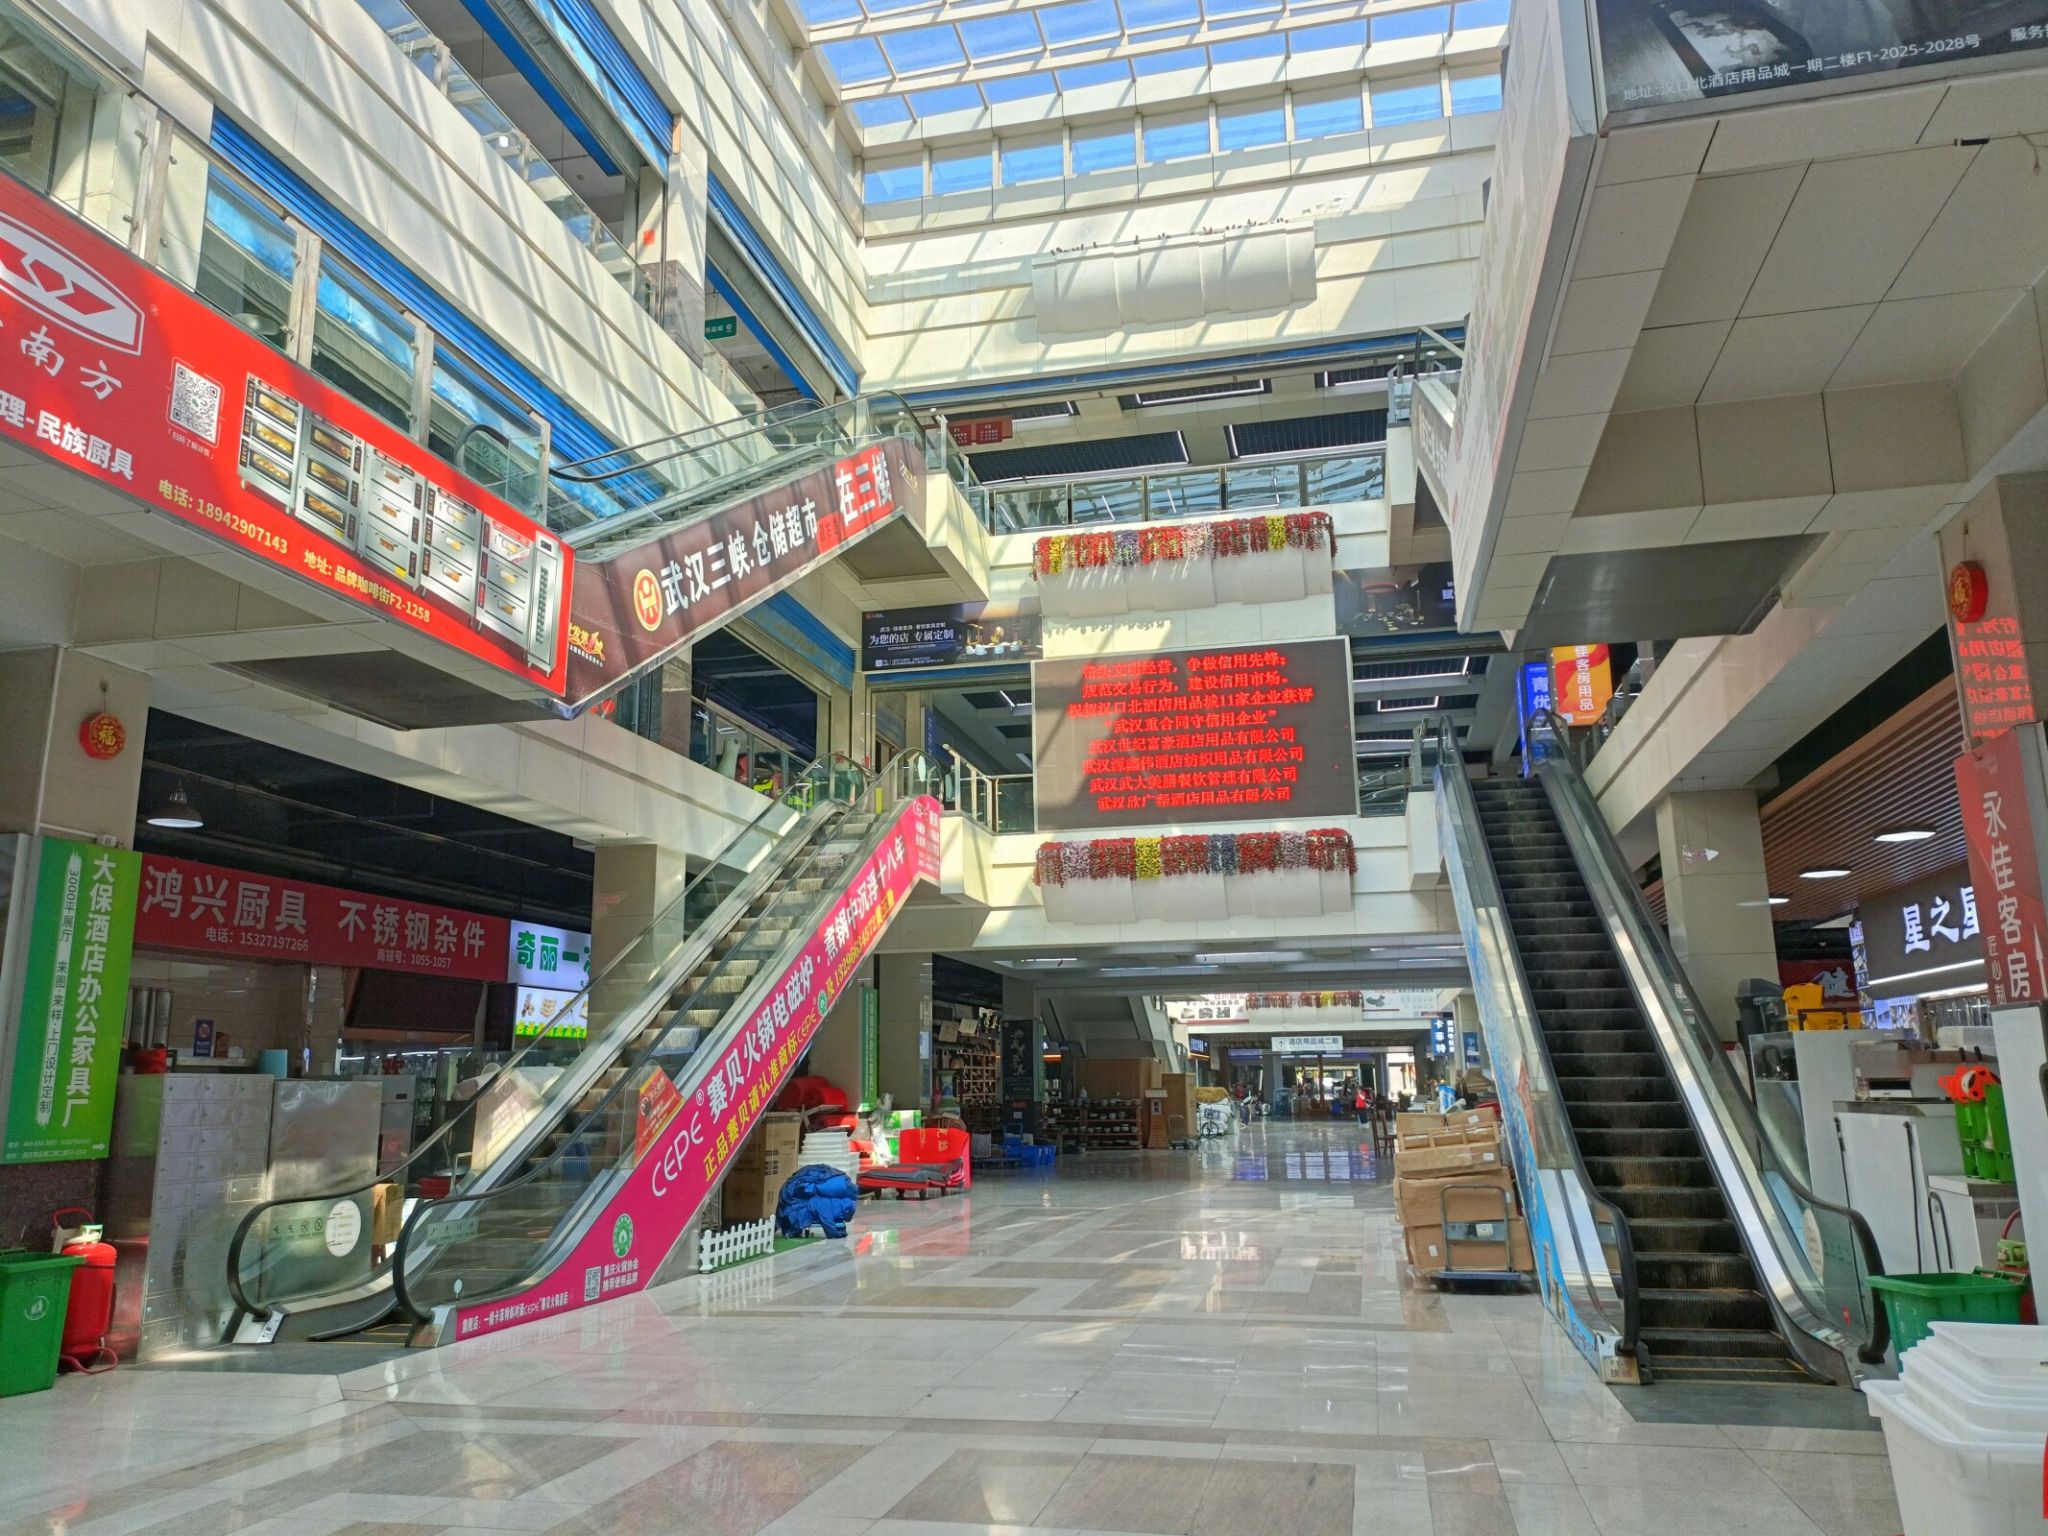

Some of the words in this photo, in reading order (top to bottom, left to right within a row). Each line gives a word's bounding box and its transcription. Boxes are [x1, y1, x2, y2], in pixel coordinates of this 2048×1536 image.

[2010, 23, 2048, 43] 服务
[197, 498, 289, 554] 18942907143
[835, 451, 893, 527] 在三楼
[869, 632, 910, 646] 为您的店
[915, 629, 954, 643] 专属定制
[143, 865, 307, 935] 鸿兴厨具
[338, 898, 486, 959] 不锈钢杂件
[1983, 790, 2031, 999] 永佳客房
[62, 853, 117, 1127] 大保酒店办公家具厂
